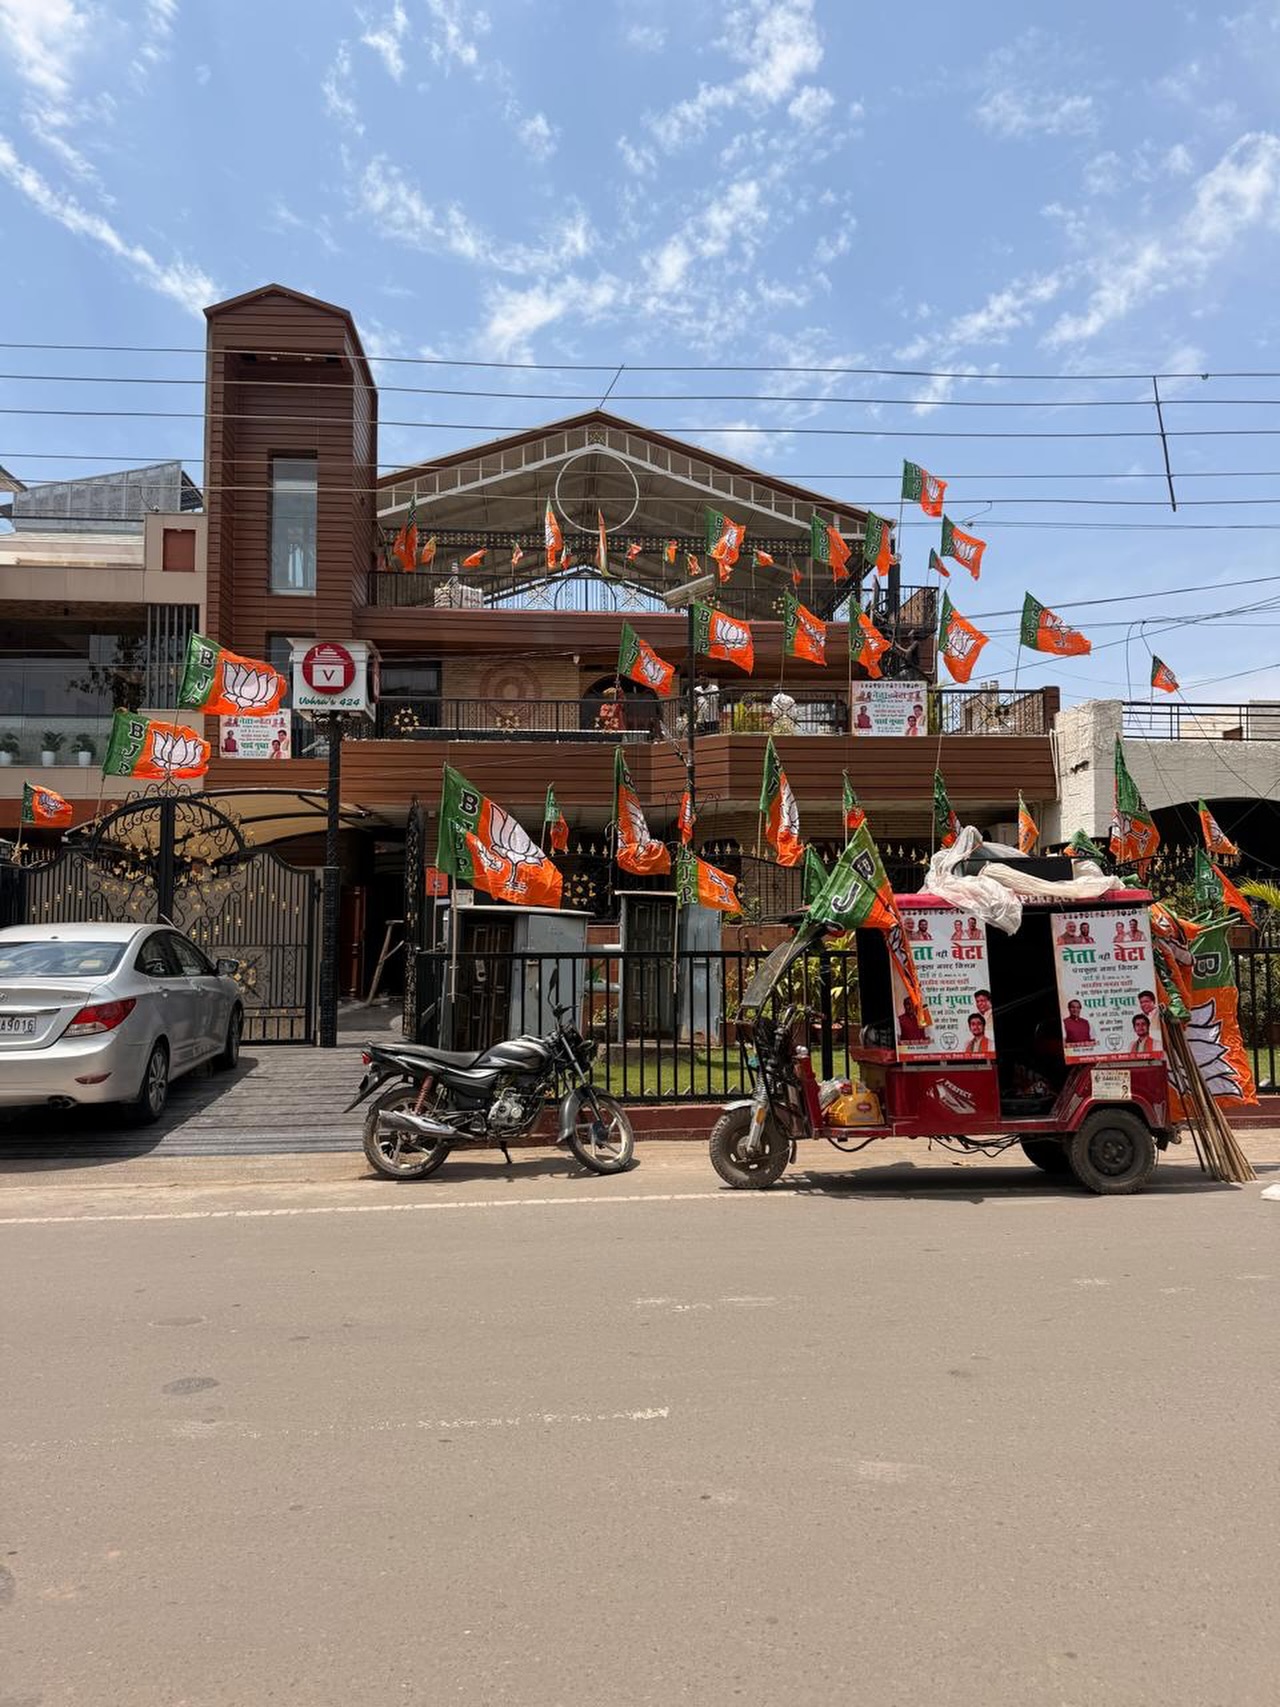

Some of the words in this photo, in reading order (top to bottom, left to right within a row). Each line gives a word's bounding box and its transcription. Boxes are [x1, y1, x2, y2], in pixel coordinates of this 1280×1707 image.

[322, 669, 335, 682] V
[340, 698, 360, 706] 424
[951, 942, 983, 960] बेटा
[1062, 947, 1096, 963] नेता
[1114, 944, 1145, 962] बेटा
